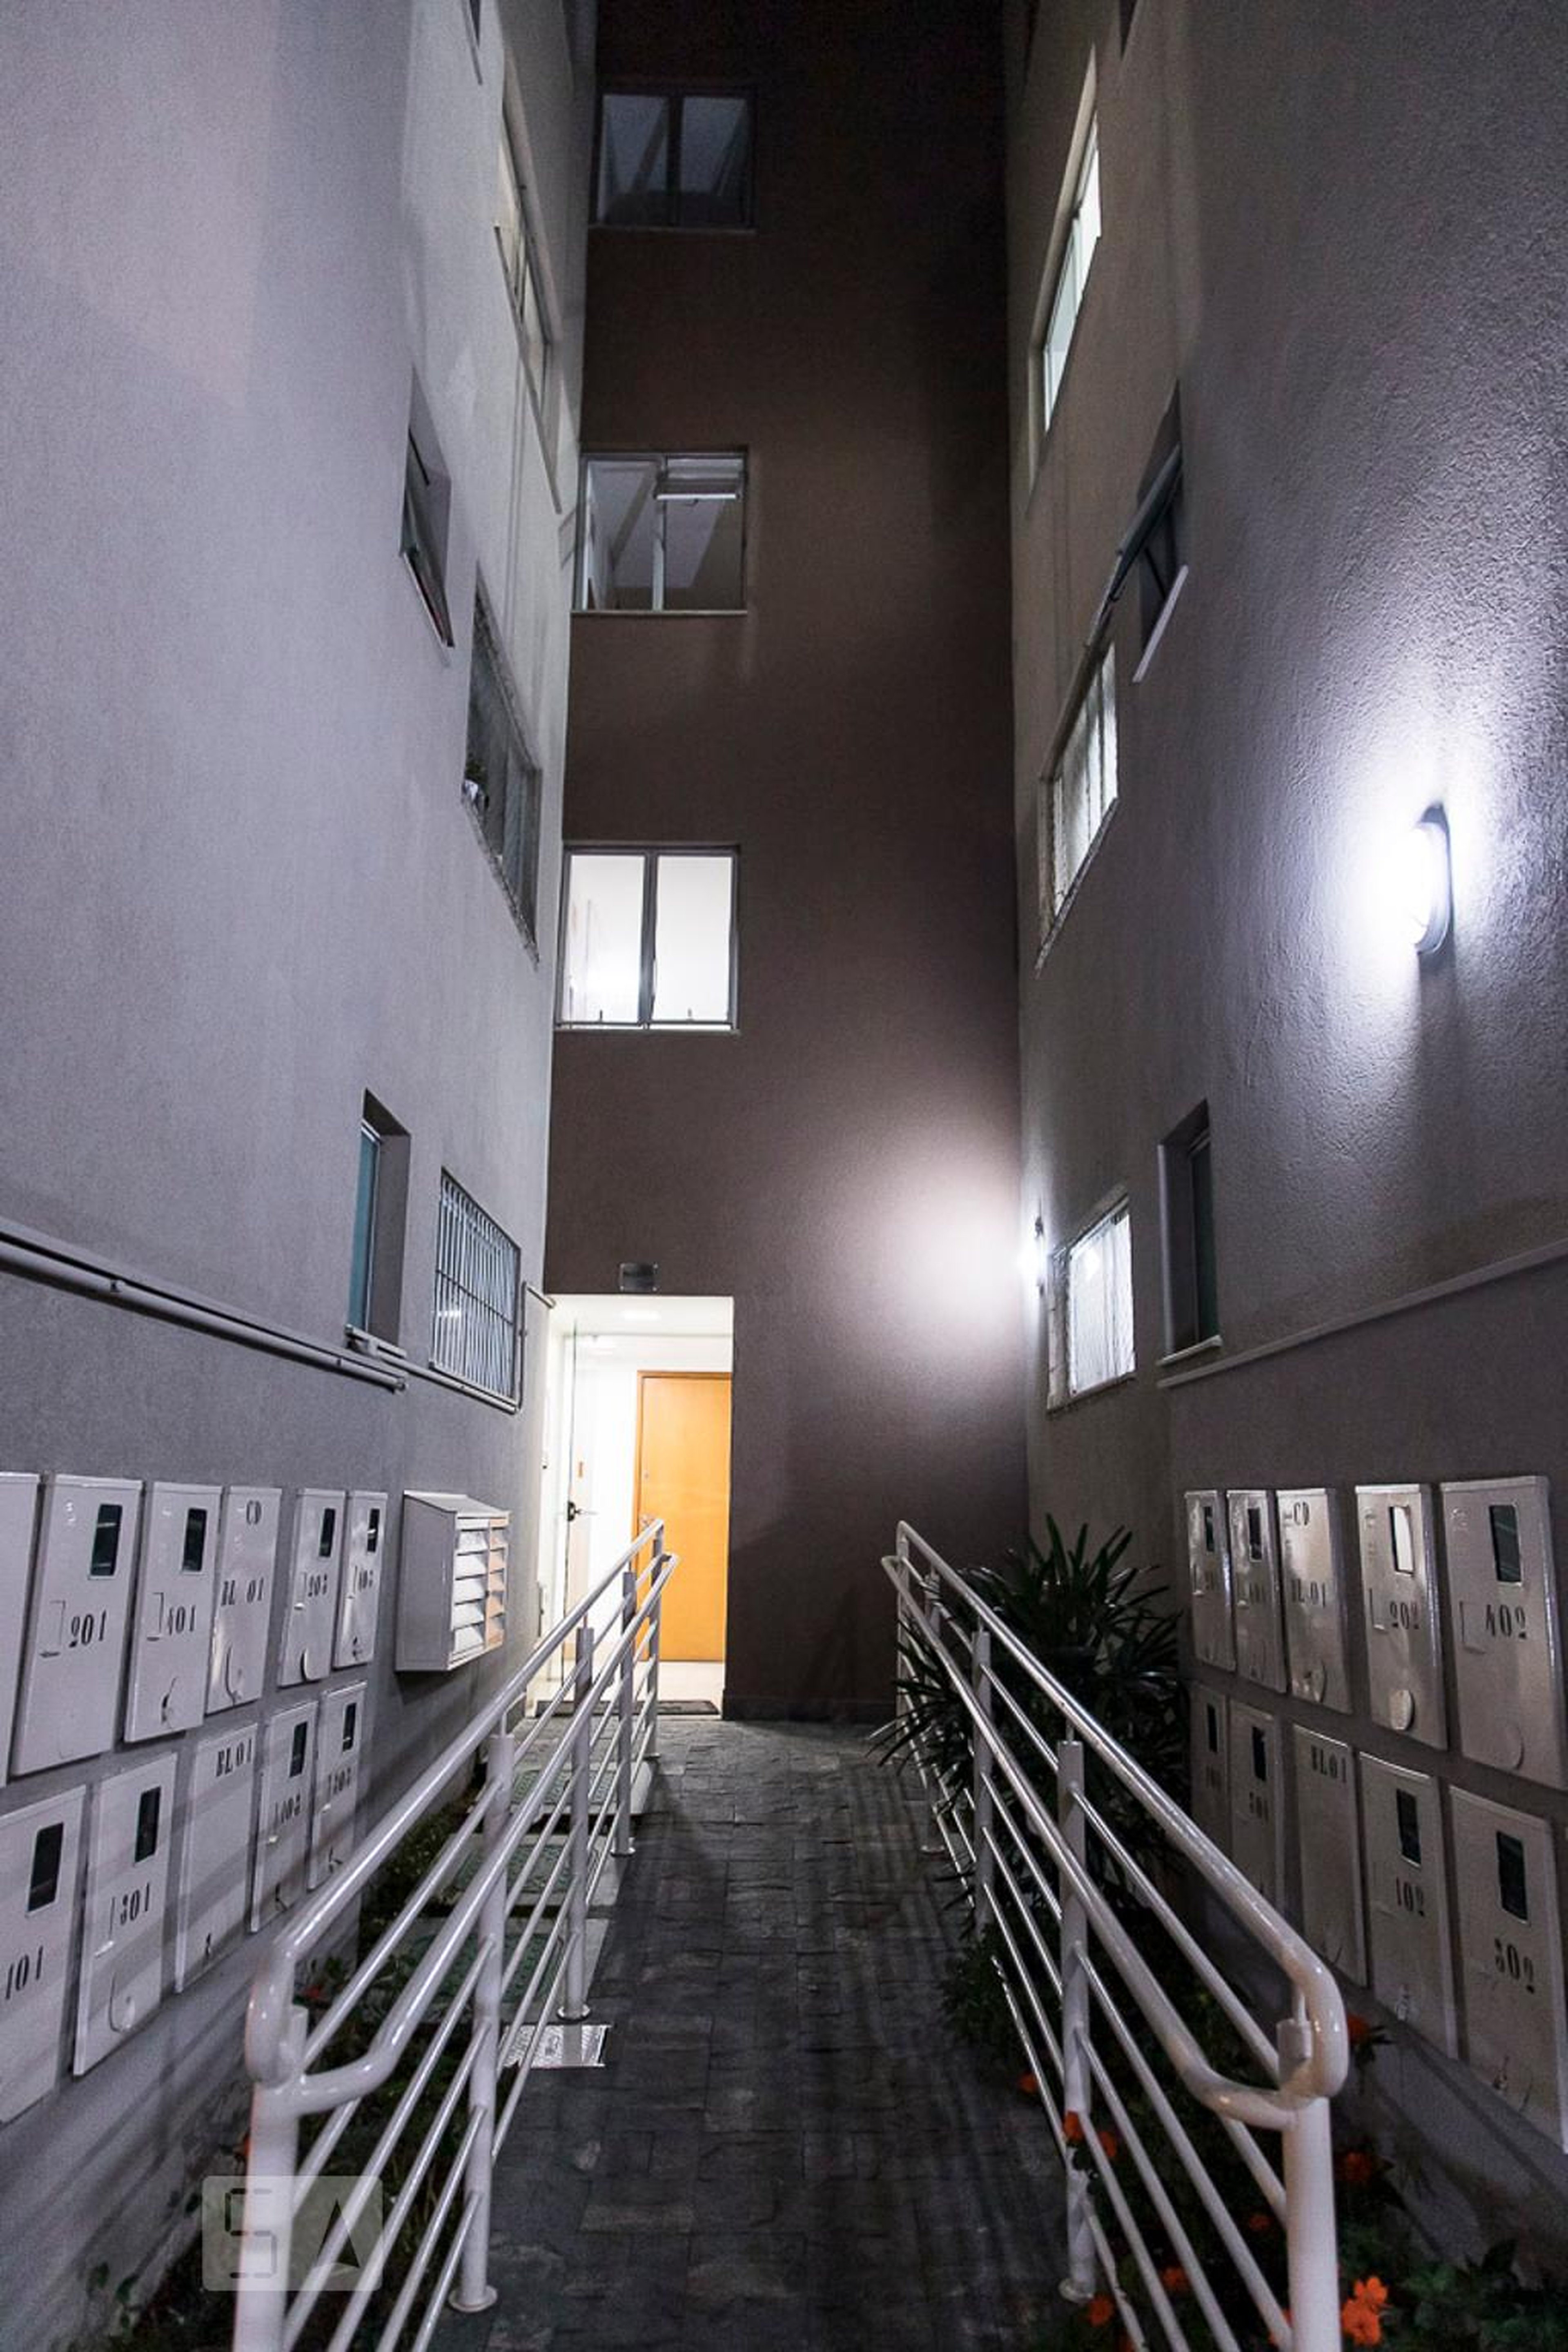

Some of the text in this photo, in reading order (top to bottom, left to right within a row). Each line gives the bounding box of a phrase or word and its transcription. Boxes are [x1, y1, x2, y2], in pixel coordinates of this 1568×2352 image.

[69, 1610, 107, 1648] 201
[1389, 1601, 1419, 1630] 202
[1486, 1604, 1526, 1639] 402
[120, 1883, 150, 1925] 301
[1396, 1878, 1425, 1917] 102
[5, 1946, 43, 2000] 101
[1495, 1938, 1535, 1994] 302
